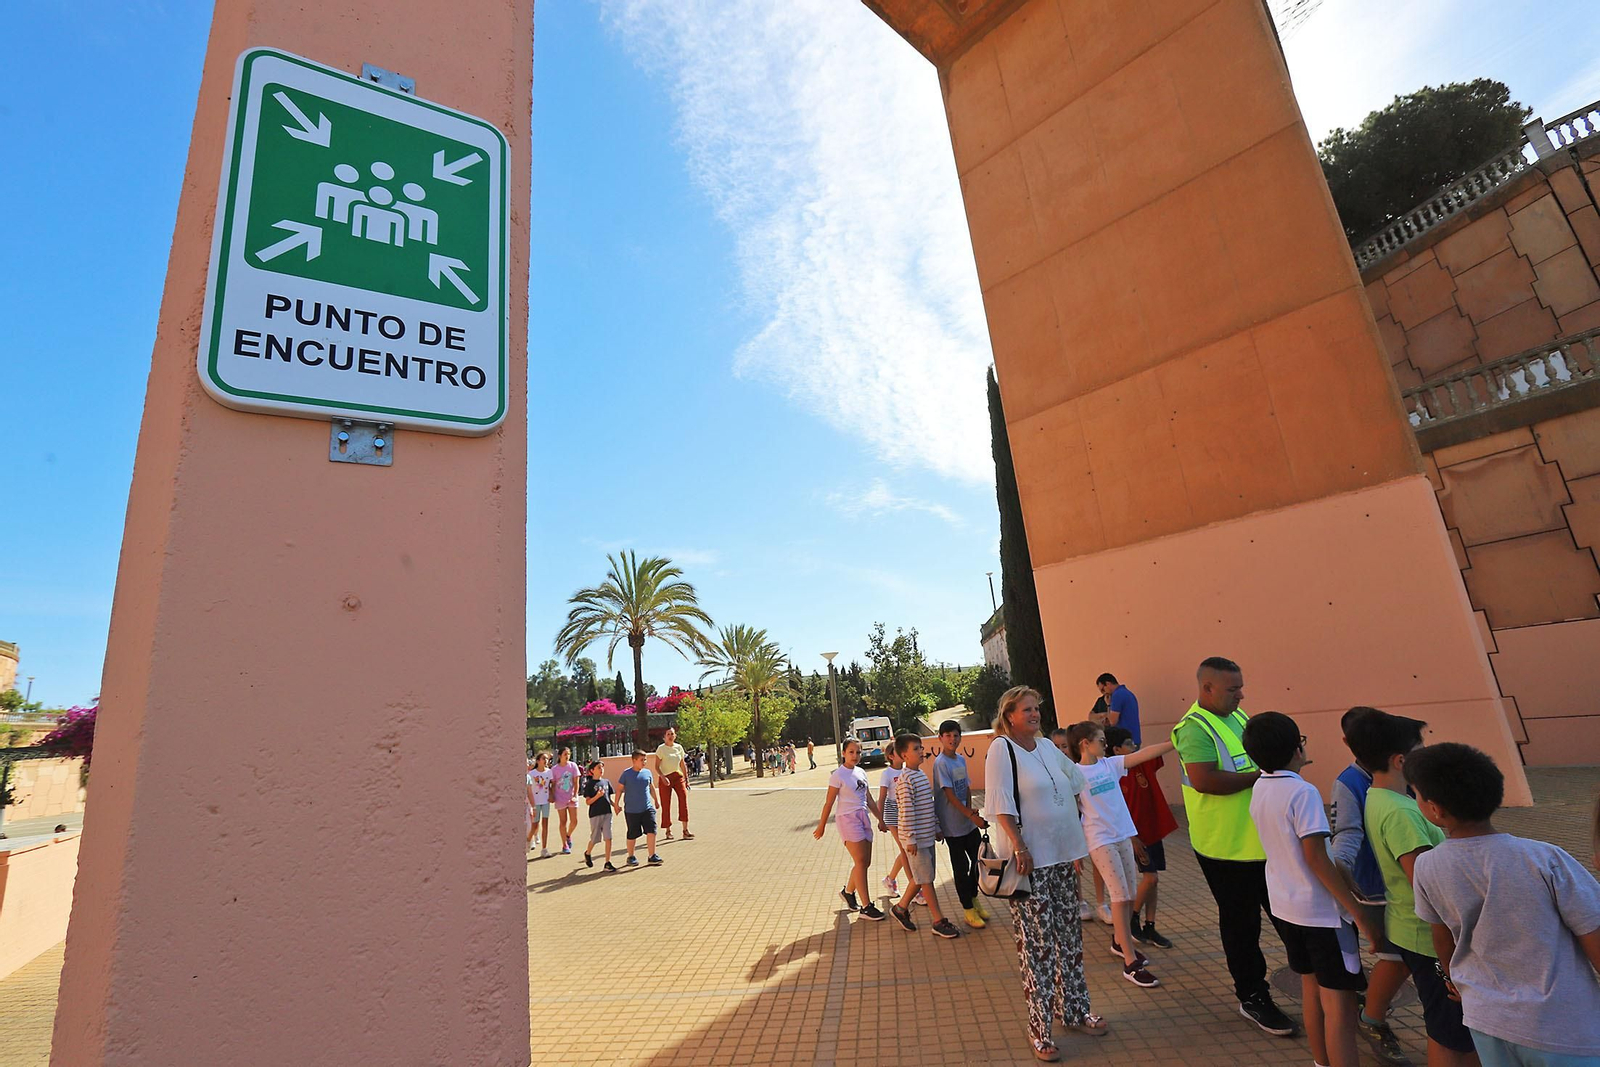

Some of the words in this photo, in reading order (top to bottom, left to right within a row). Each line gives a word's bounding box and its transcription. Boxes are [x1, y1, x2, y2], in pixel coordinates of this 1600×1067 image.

[265, 293, 406, 340] PUNTO
[418, 321, 466, 352] DE
[233, 328, 487, 390] ENCUENTRO
